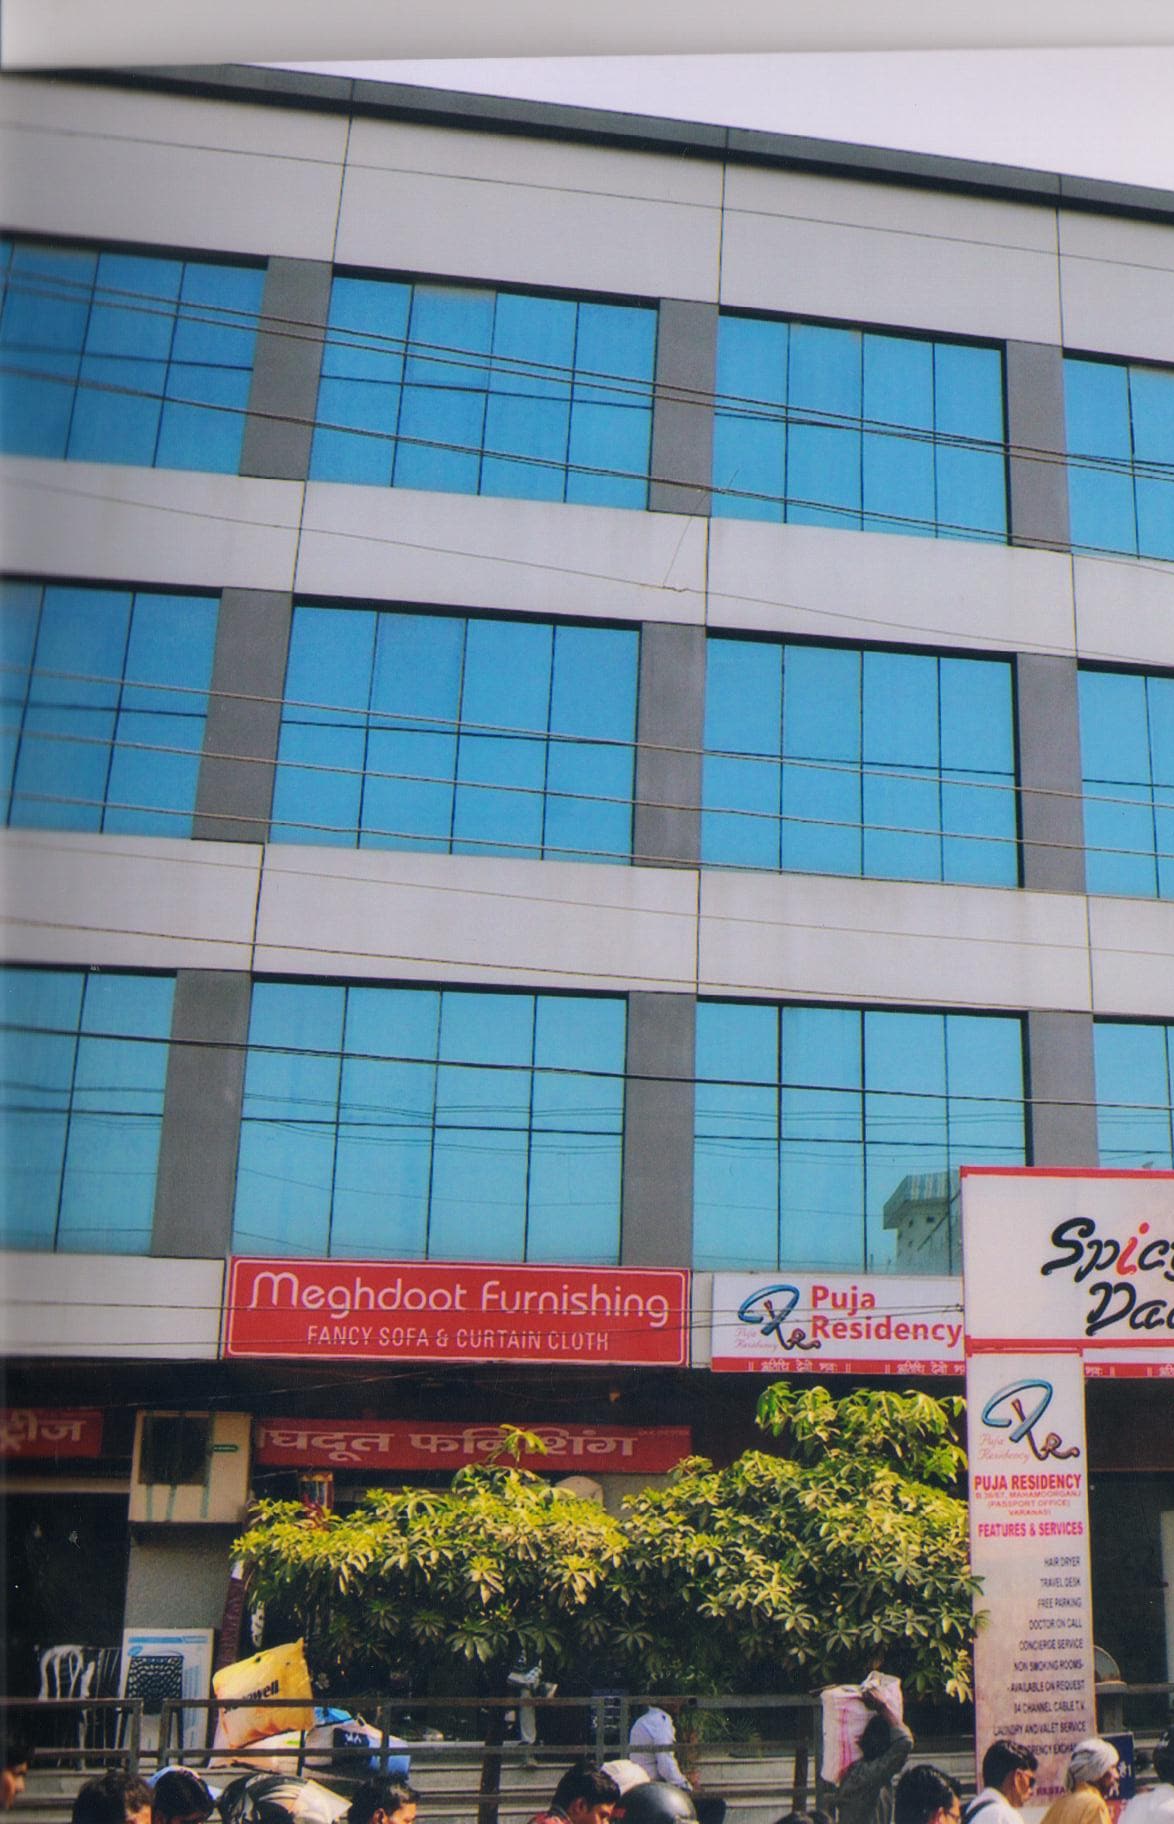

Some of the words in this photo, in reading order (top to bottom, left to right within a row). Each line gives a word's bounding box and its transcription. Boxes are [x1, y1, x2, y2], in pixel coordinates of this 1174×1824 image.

[248, 1271, 467, 1319] Meghdoot
[481, 1280, 669, 1328] Furnishing
[811, 1285, 876, 1316] Puja
[811, 1315, 962, 1347] Residency
[307, 1325, 373, 1346] FANCY
[379, 1327, 429, 1347] SOFA
[436, 1328, 448, 1347] &
[456, 1328, 541, 1350] CURTAIN
[548, 1331, 609, 1351] CLOTH
[974, 1475, 1007, 1490] PUJA
[1011, 1474, 1081, 1490] RESIDENCY
[978, 1523, 1026, 1537] FEATURES
[1030, 1522, 1036, 1536] &
[1039, 1521, 1083, 1536] SERVICES
[1044, 1557, 1058, 1567] HAIR
[1061, 1556, 1080, 1567] DRYER
[1041, 1578, 1063, 1588] TRAVEL
[1065, 1577, 1080, 1587] DESK
[1038, 1598, 1053, 1608] FREE
[1055, 1597, 1081, 1608] PARKING
[1029, 1619, 1055, 1630] DOCTOR
[1056, 1619, 1065, 1629] ON
[1067, 1618, 1082, 1628] CALL
[1019, 1639, 1056, 1651] CONCIERGE
[1058, 1638, 1083, 1649] SERVICE
[1014, 1661, 1028, 1671] NON
[1030, 1660, 1058, 1671] SMOKING
[1045, 1681, 1055, 1692] ON
[1056, 1680, 1085, 1691] REQUEST
[1023, 1702, 1052, 1713] CHANNEL
[1054, 1701, 1074, 1711] CABLE
[1025, 1724, 1037, 1734] AND
[1060, 1720, 1086, 1733] SERVICE
